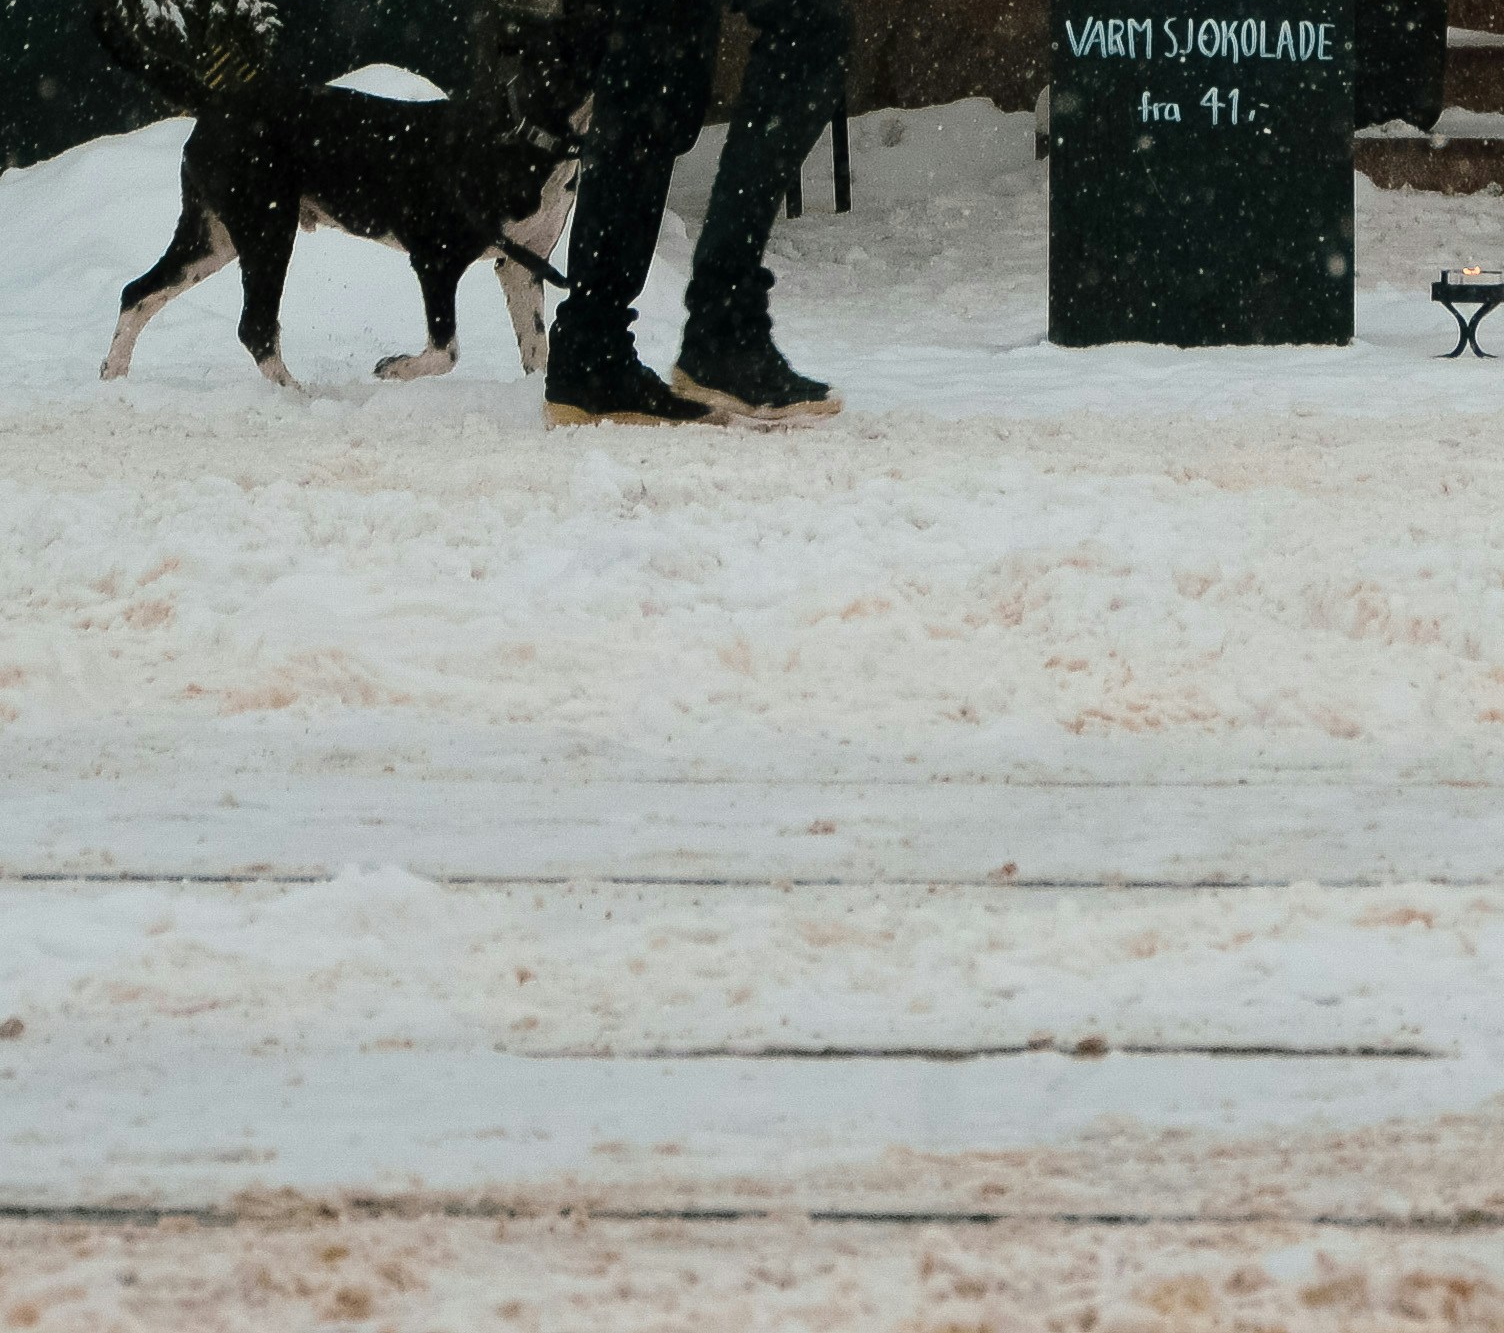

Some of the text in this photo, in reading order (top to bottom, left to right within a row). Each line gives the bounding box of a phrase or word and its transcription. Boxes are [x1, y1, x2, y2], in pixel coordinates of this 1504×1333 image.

[1065, 16, 1336, 64] VARM SJOKOLADE
[1138, 90, 1182, 123] fra
